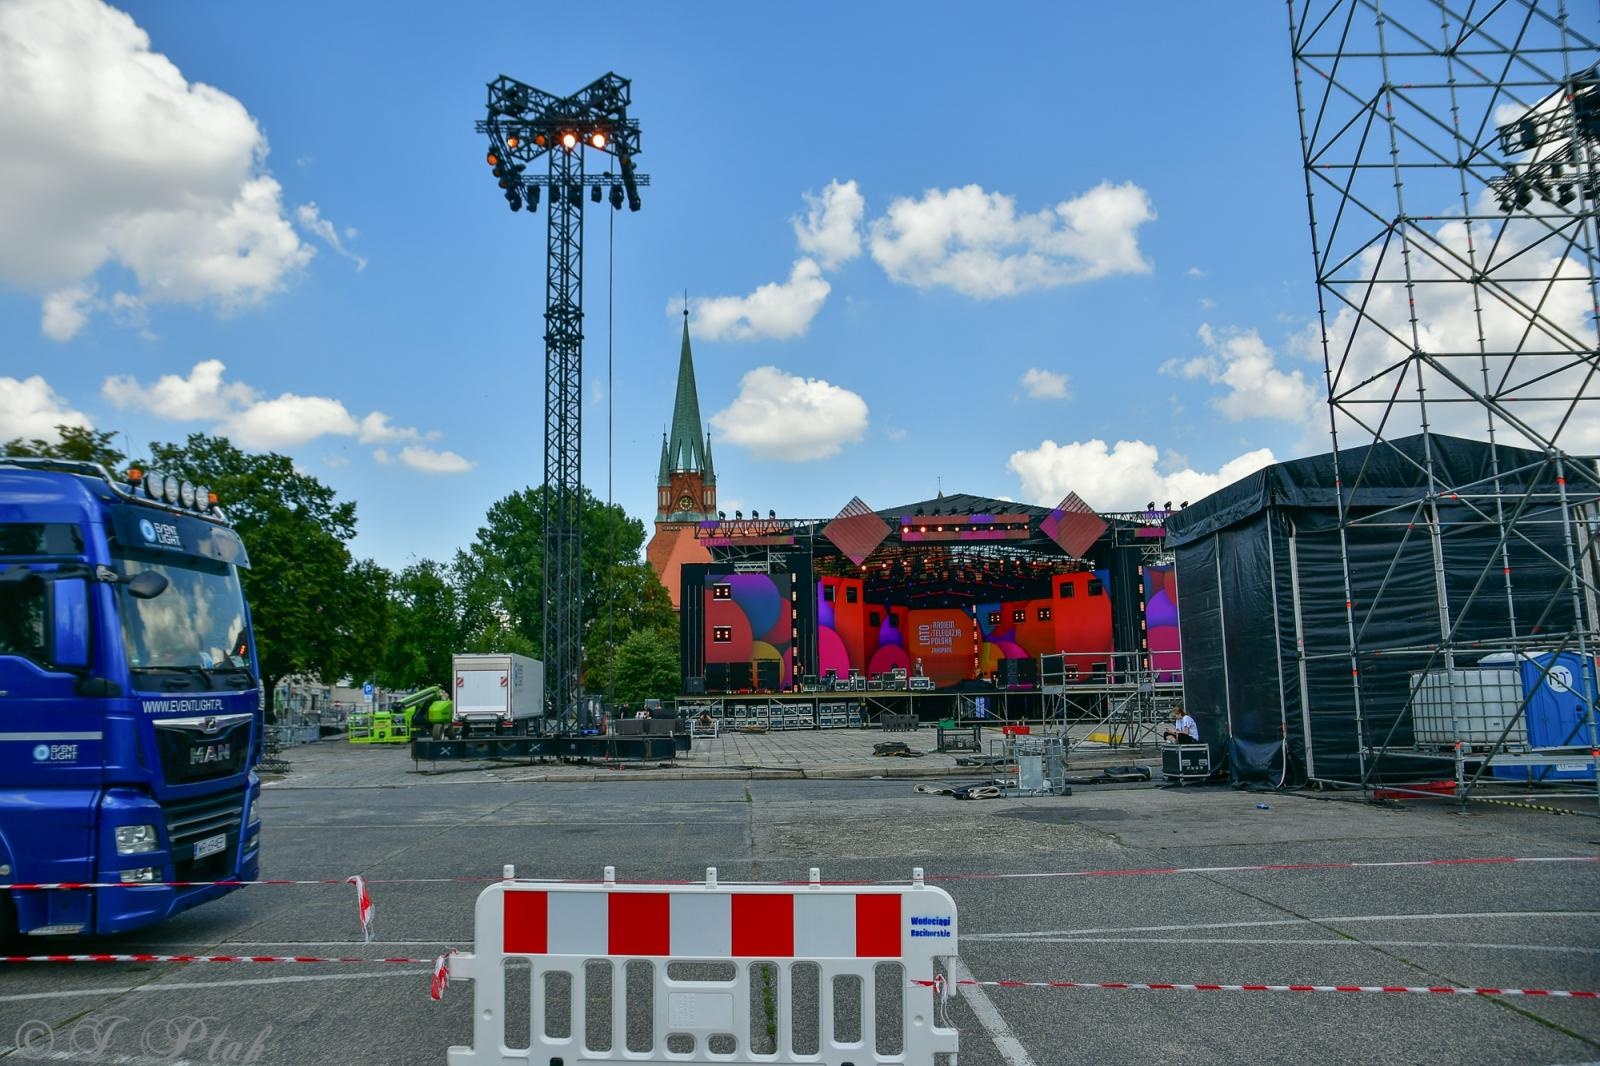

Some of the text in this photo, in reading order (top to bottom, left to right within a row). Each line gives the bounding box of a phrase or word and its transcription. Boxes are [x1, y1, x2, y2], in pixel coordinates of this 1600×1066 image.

[156, 532, 181, 546] LIGHT
[918, 624, 930, 645] LATO
[142, 699, 225, 714] WWW.EVENTLIGHT.PL
[50, 744, 78, 753] EVENT
[190, 744, 230, 765] MAN
[50, 752, 78, 760] LIGHT
